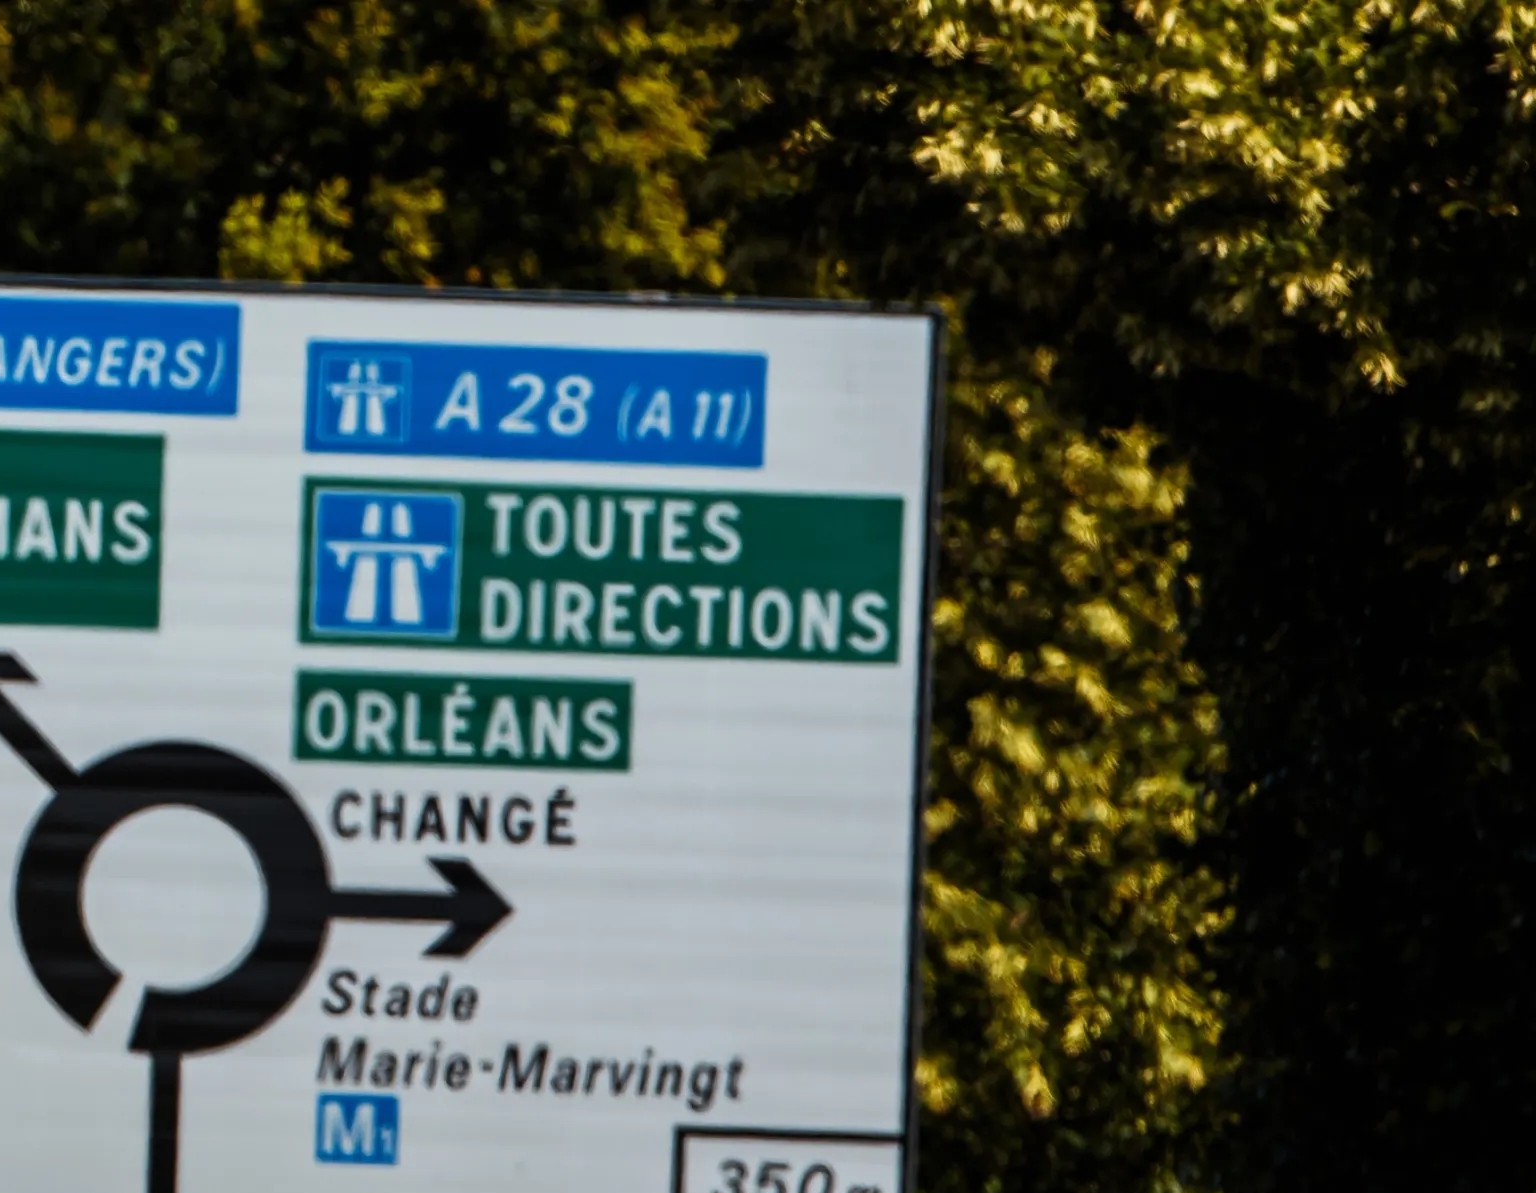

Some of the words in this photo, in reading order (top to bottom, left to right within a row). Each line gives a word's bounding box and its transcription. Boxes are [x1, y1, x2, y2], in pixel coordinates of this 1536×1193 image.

[436, 372, 480, 431] A
[498, 373, 593, 435] 28
[618, 384, 672, 441] (A
[691, 390, 752, 447] 11)
[486, 494, 742, 563] TOUTES
[480, 578, 889, 654] DIRECTIONS
[305, 684, 620, 760] ORLÉANS
[330, 787, 577, 846] CHANGÉ
[321, 970, 480, 1022] Stade
[316, 1036, 745, 1113] Marie-Marvingt
